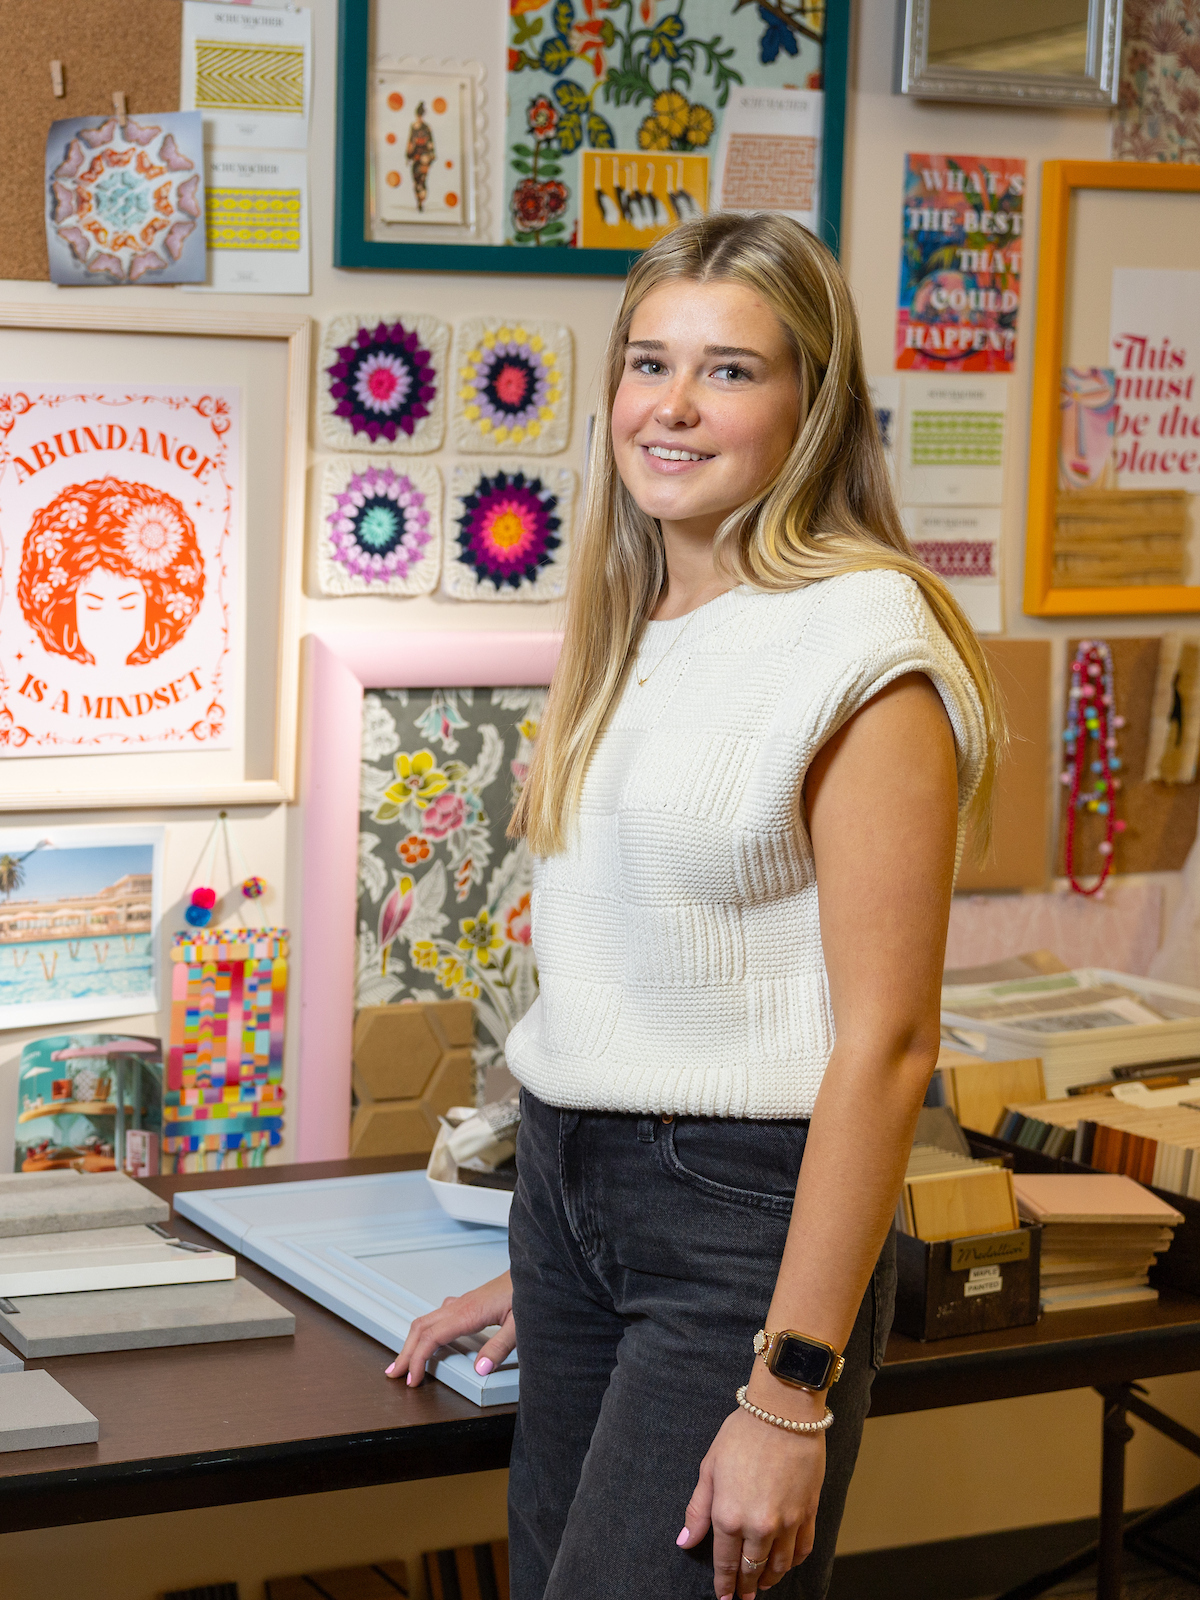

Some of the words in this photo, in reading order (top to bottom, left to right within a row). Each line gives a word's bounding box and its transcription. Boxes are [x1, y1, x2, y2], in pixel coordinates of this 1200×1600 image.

[921, 168, 1024, 196] WHAT'S
[907, 207, 957, 231] THE
[963, 210, 1024, 235] BEST
[956, 248, 1022, 273] THAT
[929, 287, 1018, 313] COULD
[904, 325, 1016, 352] HAPPEN?
[1113, 332, 1185, 370] This
[1114, 373, 1195, 400] must
[13, 423, 218, 486] ABUNDANCE
[18, 673, 49, 702] IS
[50, 689, 70, 715] A
[79, 666, 204, 719] MINDSET
[967, 1281, 1000, 1291] PAINTED
